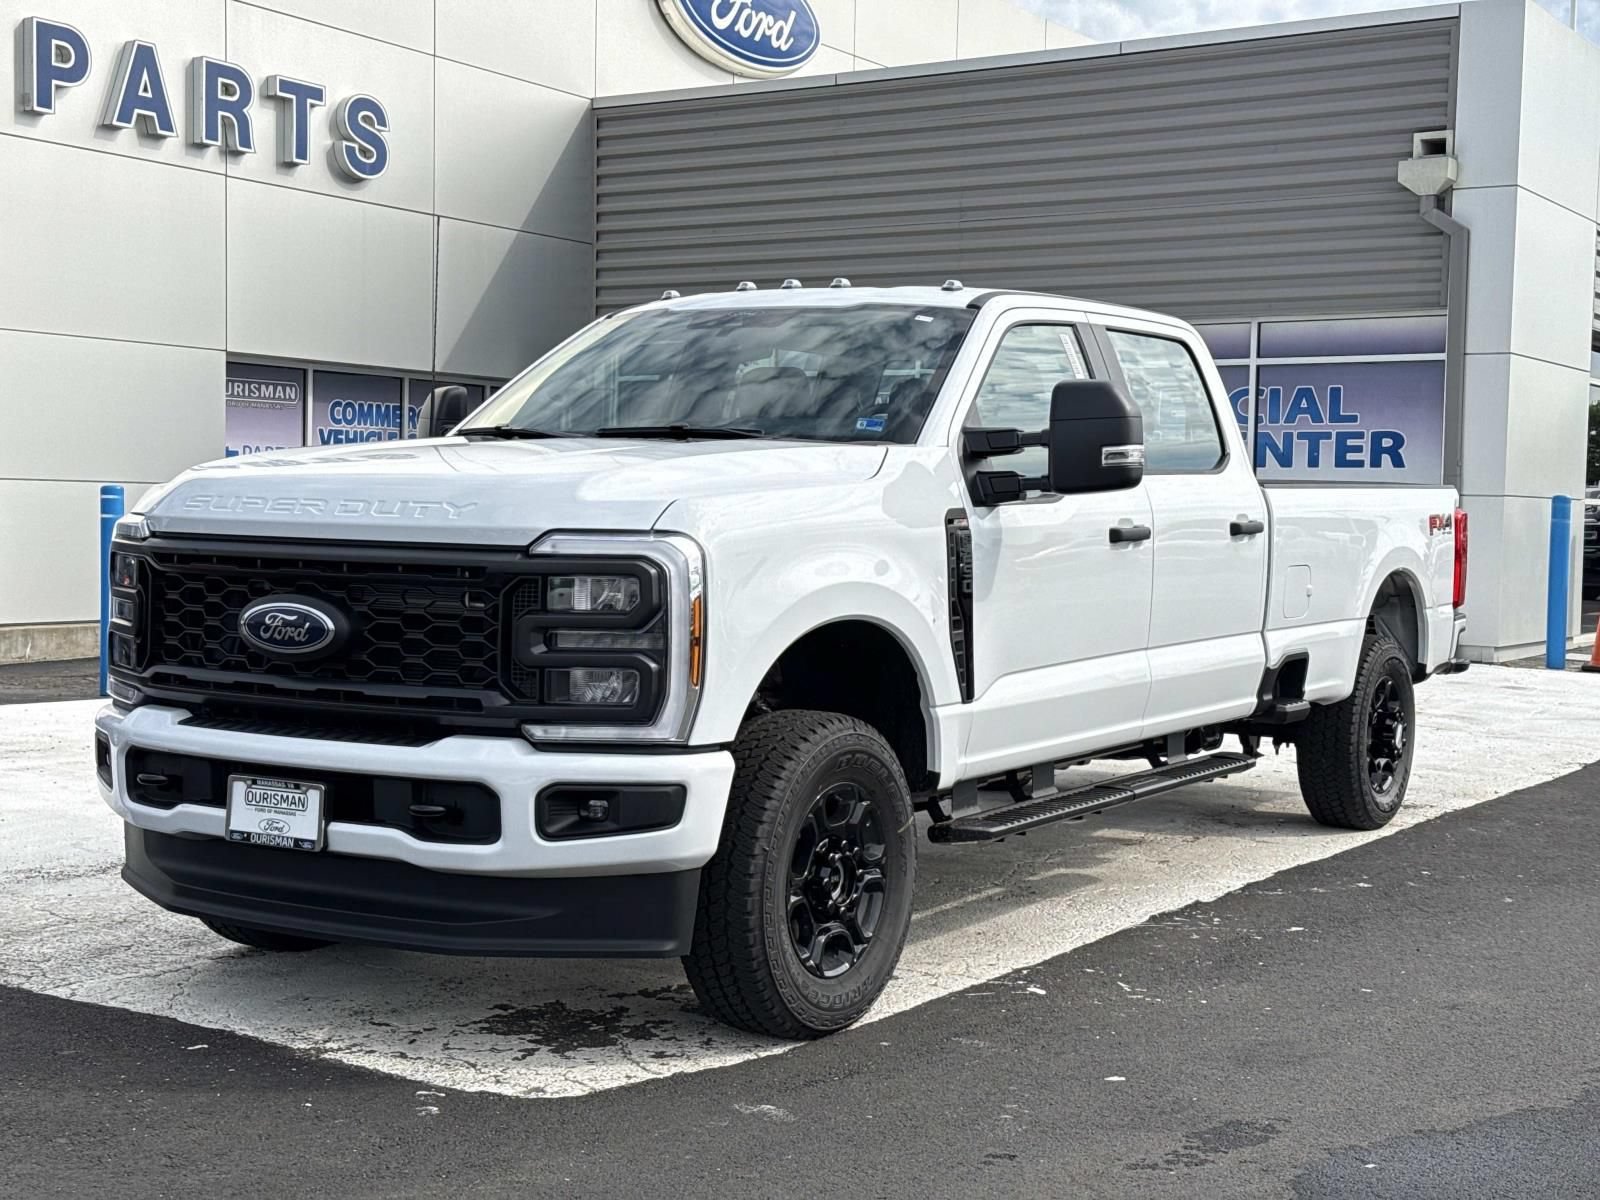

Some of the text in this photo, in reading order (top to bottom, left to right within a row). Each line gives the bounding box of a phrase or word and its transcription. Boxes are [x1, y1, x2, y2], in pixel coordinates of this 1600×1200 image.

[23, 16, 391, 180] PARTS
[329, 399, 421, 430] COMMER
[1242, 430, 1407, 469] NTER
[183, 494, 479, 519] SUPER DUTY
[260, 612, 311, 643] Ford
[246, 790, 306, 809] OURISMAN
[250, 832, 295, 848] OURISMAN
[263, 820, 285, 833] Ford
